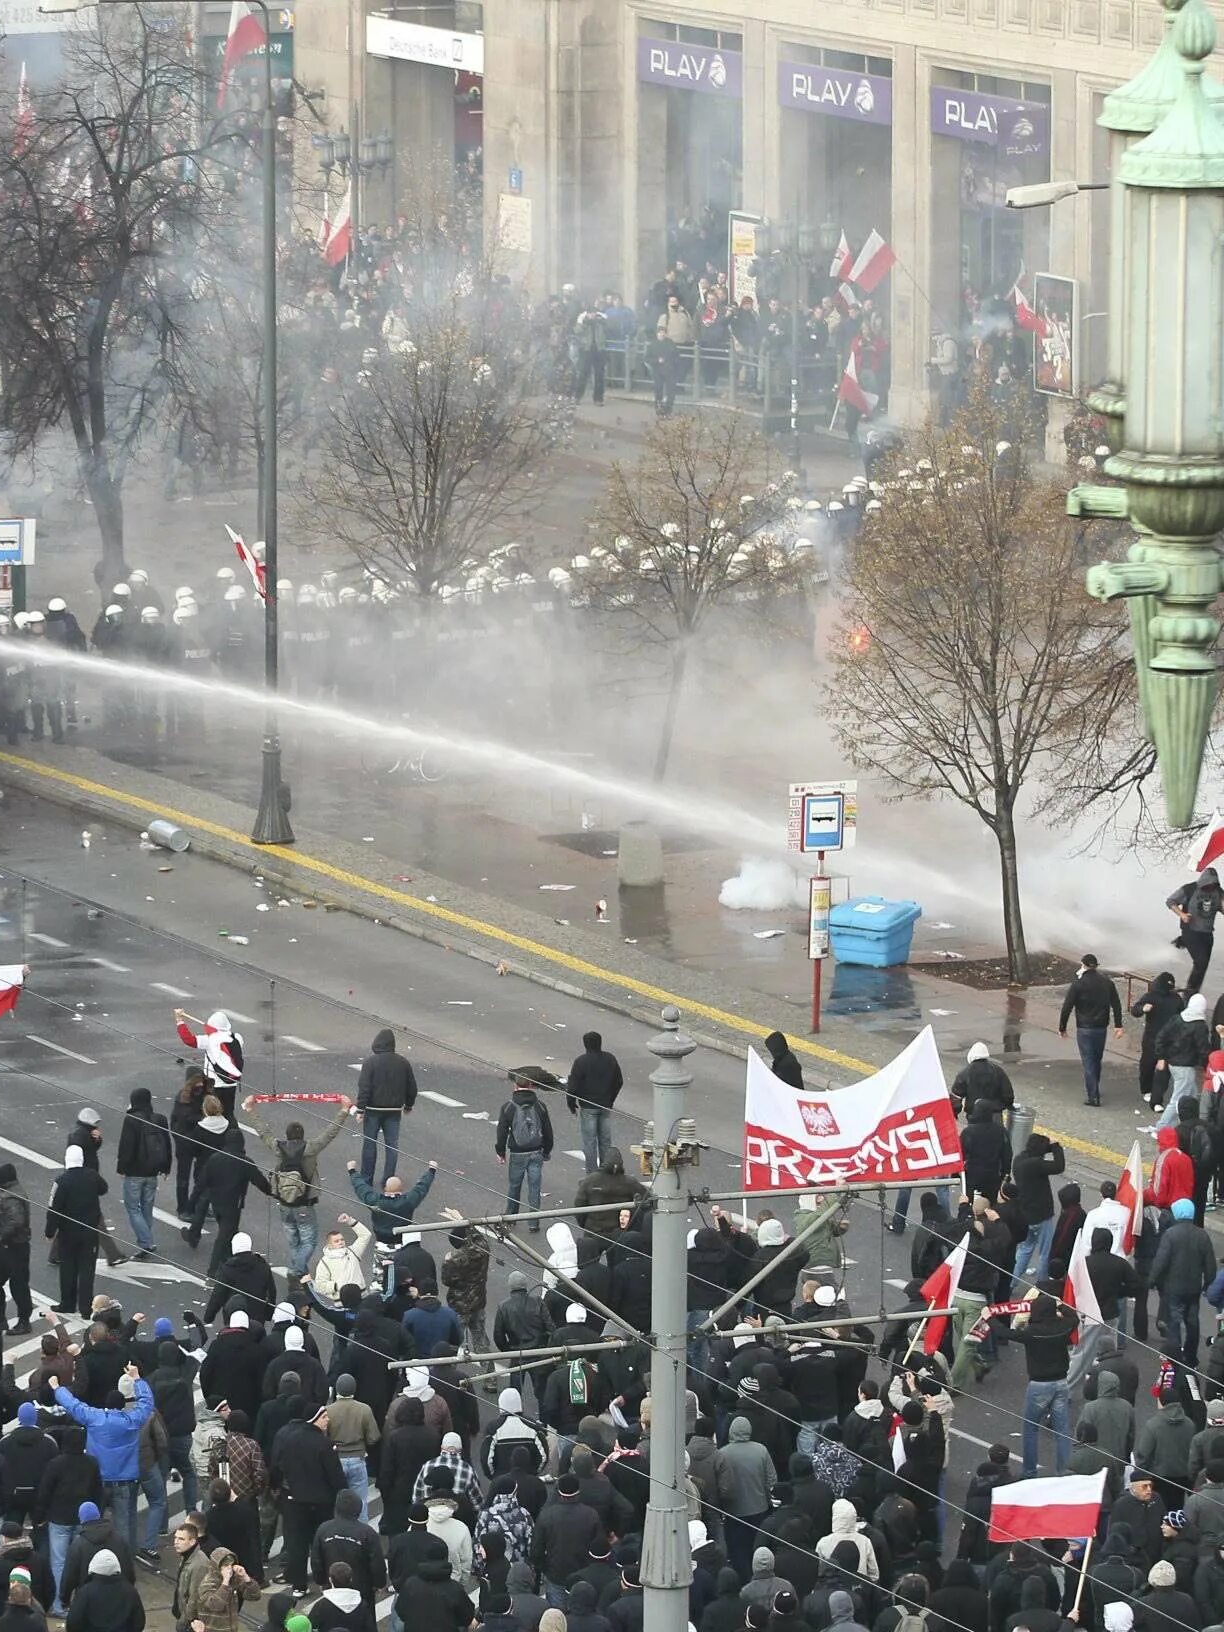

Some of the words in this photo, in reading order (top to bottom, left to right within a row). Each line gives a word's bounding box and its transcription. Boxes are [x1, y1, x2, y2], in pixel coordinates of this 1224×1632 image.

[651, 49, 706, 81] PLAY
[792, 73, 852, 106] PLAY
[1006, 143, 1042, 155] PLAY
[746, 1108, 960, 1186] PRZEMYŚL
